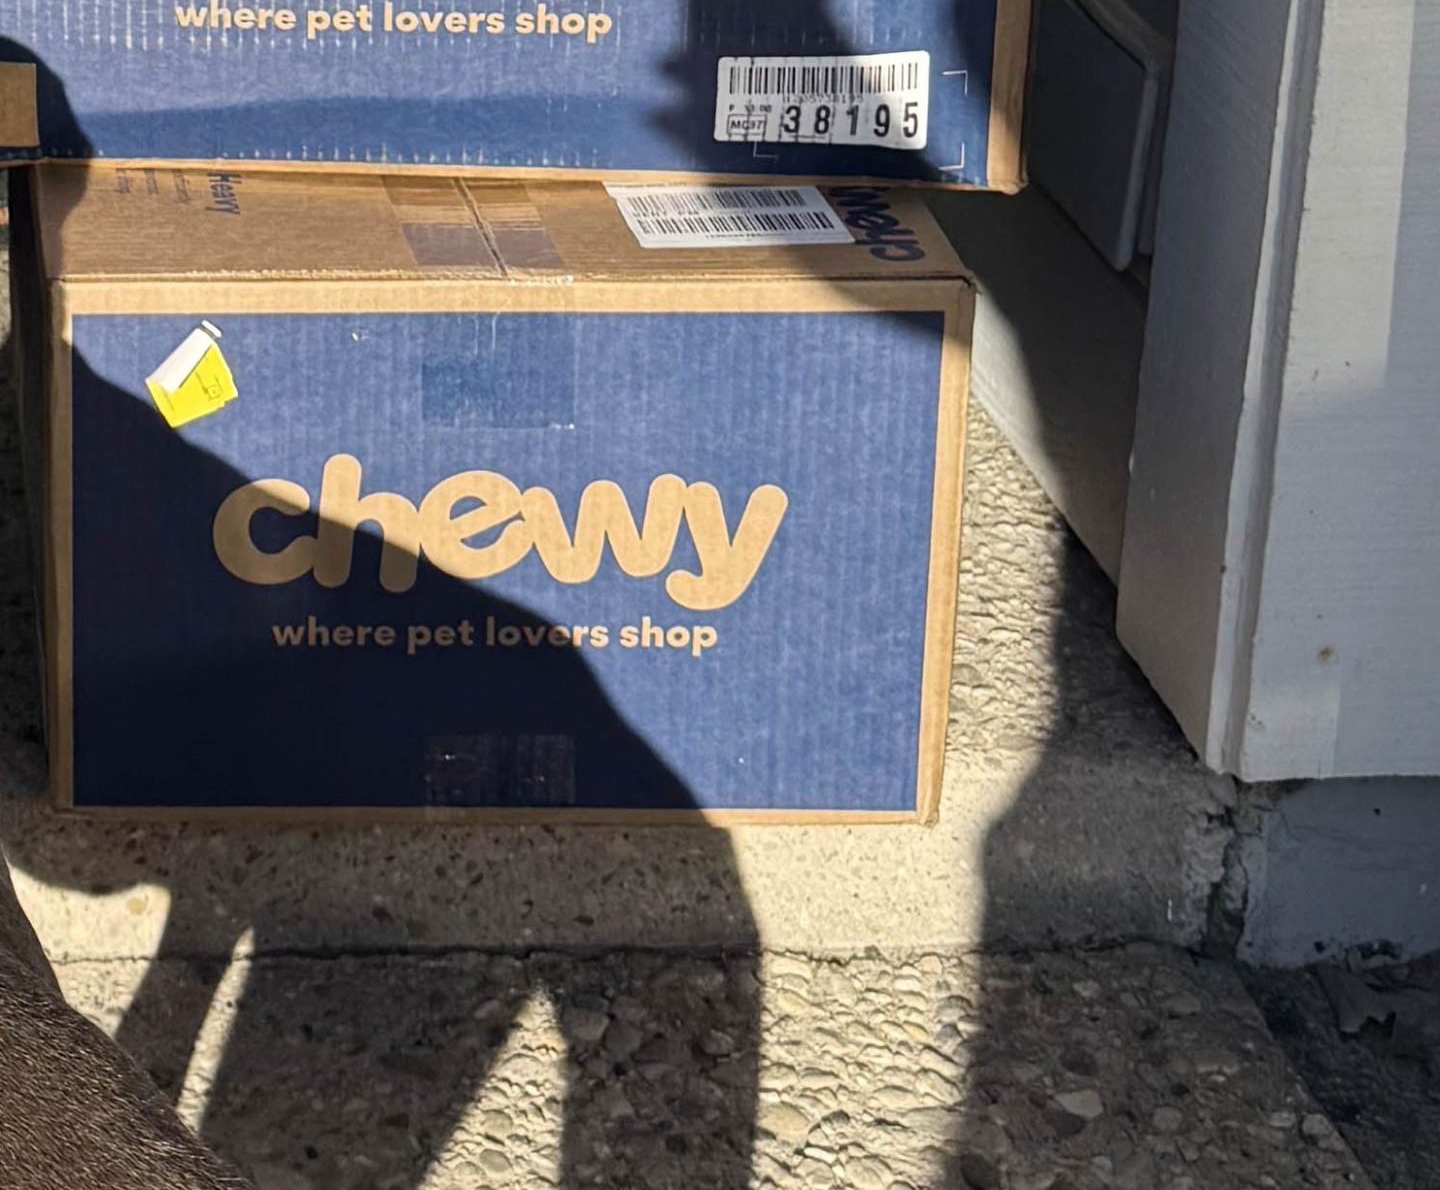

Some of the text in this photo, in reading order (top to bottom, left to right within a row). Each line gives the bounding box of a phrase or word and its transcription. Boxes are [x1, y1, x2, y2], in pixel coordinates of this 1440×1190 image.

[306, 1, 373, 41] pet
[383, 2, 505, 36] lovers
[514, 3, 613, 44] shop
[782, 101, 919, 138] 38195
[205, 172, 242, 215] Heavy
[212, 453, 789, 611] chewy
[271, 616, 719, 658] where pet lovers shop
